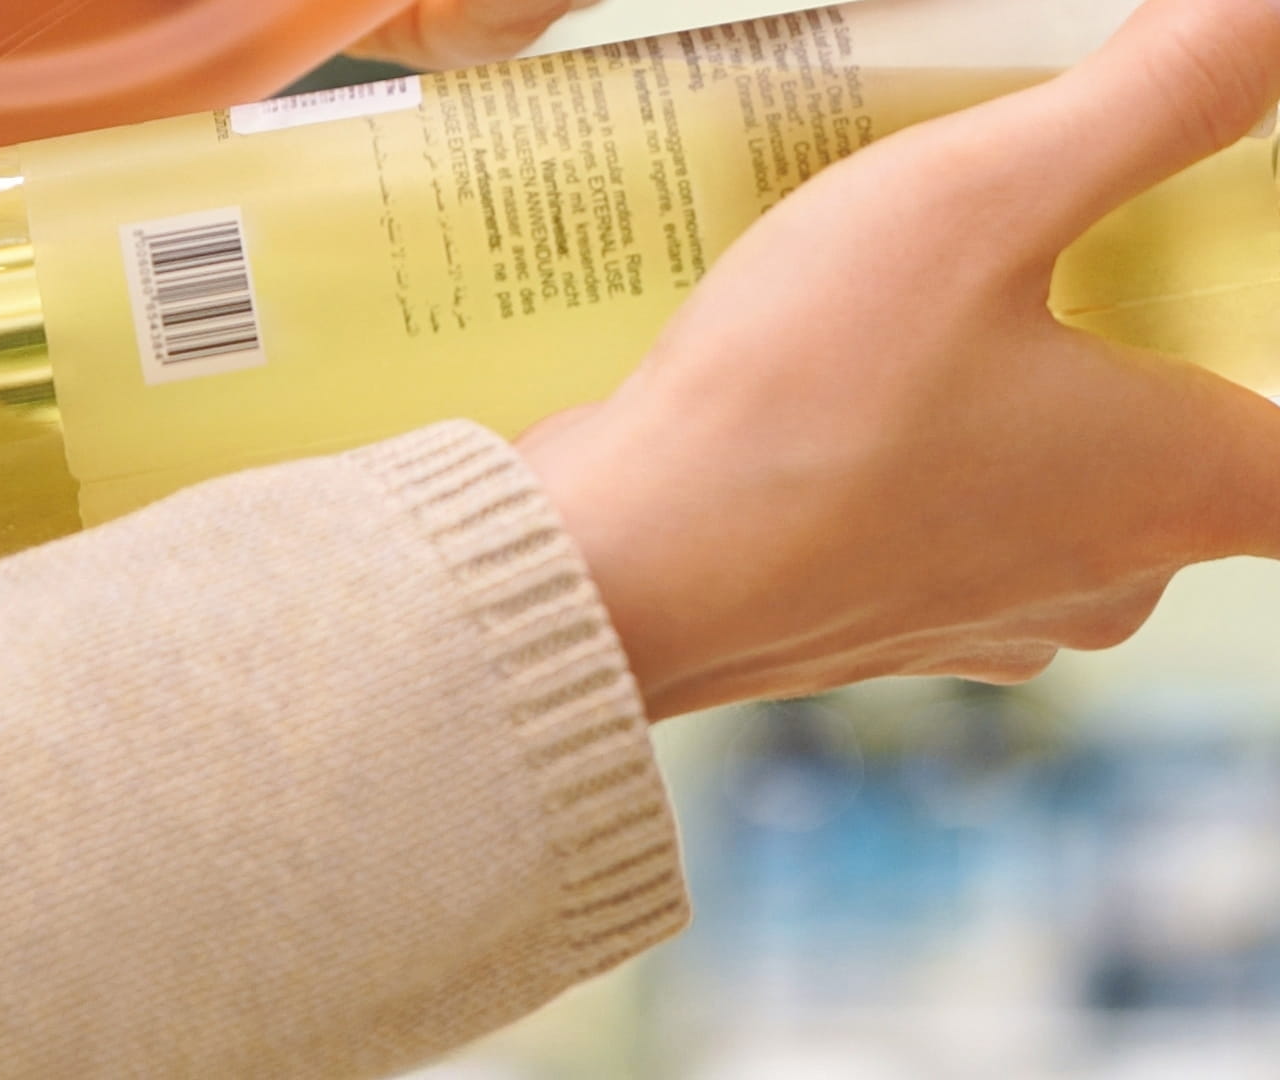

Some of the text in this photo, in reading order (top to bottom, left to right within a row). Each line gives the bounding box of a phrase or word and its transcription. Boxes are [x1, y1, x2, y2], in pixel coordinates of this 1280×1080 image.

[646, 129, 661, 153] non
[447, 137, 475, 204] EXTERNE.
[497, 167, 513, 180] et
[562, 159, 579, 185] und
[747, 137, 774, 198] Linalool,
[570, 191, 587, 214] mit
[649, 159, 673, 217] ingerire,
[677, 179, 694, 205] con
[503, 185, 523, 238] masser
[587, 175, 616, 258] EXTERNAL
[511, 245, 529, 281] avec
[526, 191, 558, 300] ANWENDUNG.
[575, 221, 601, 304] kreisenden
[663, 223, 684, 274] evitare
[494, 262, 508, 283] ne
[562, 271, 581, 308] nicht
[625, 253, 644, 296] Rinse
[495, 290, 515, 320] pas
[519, 287, 536, 315] des
